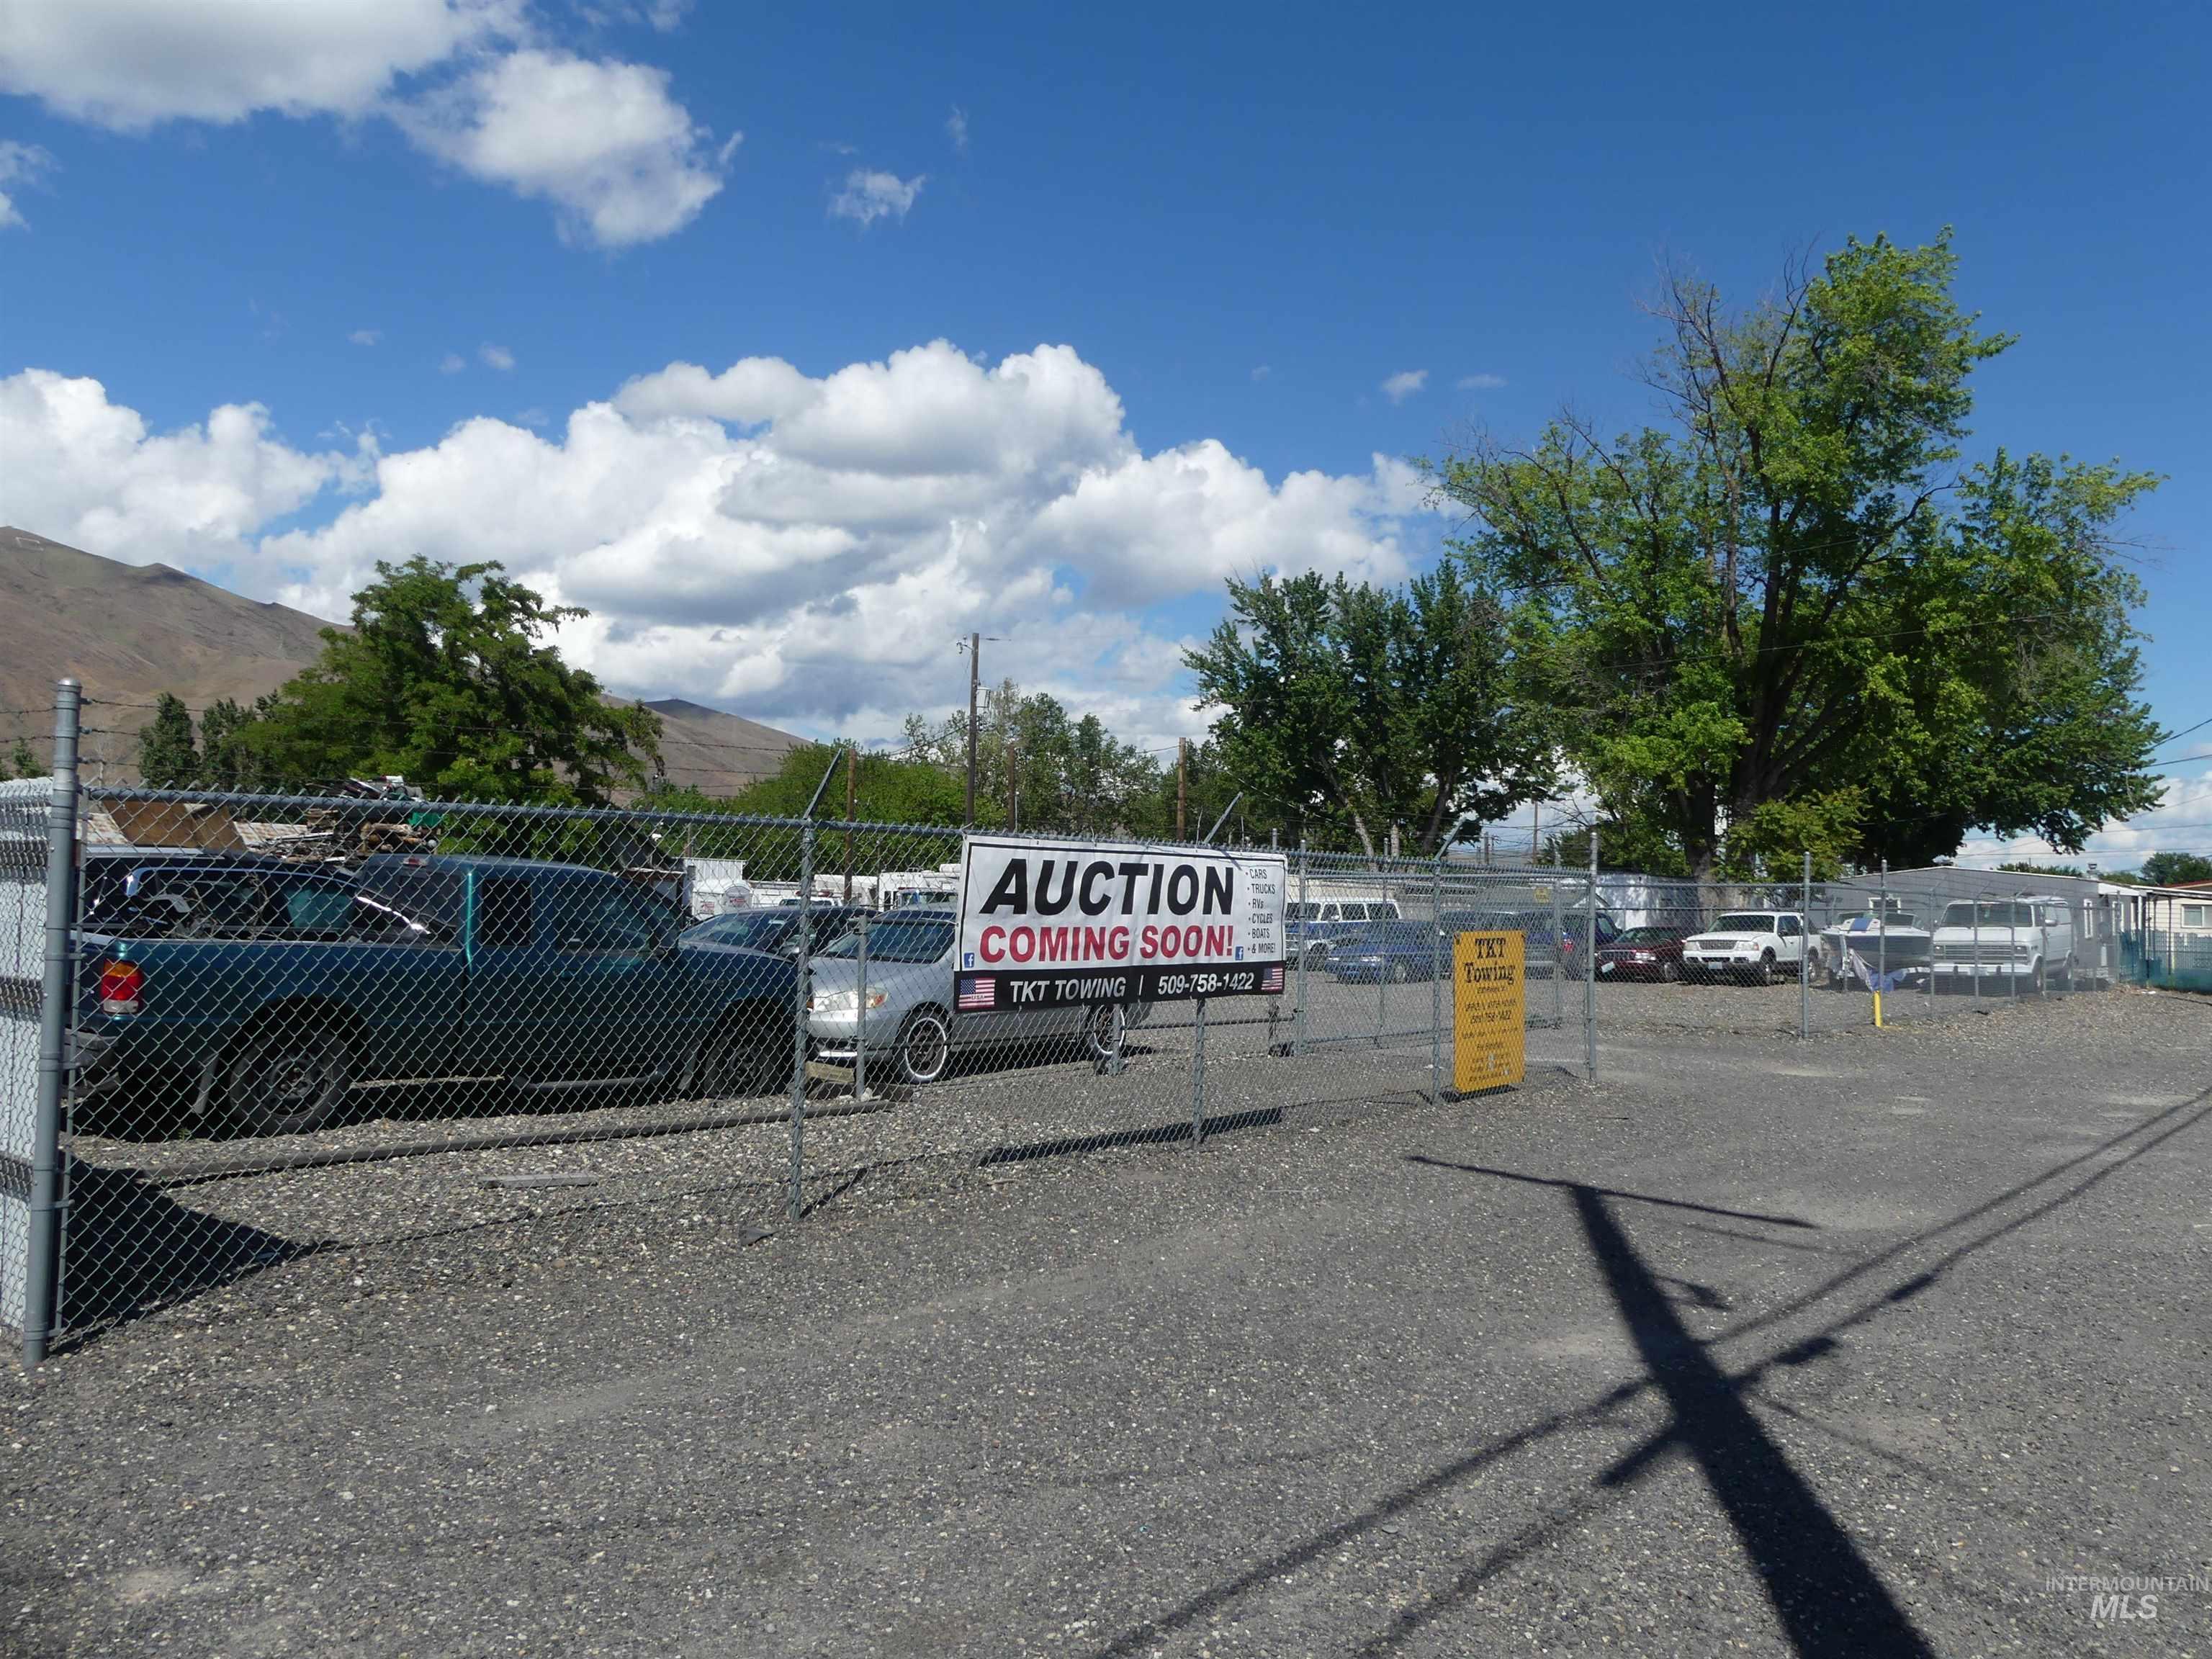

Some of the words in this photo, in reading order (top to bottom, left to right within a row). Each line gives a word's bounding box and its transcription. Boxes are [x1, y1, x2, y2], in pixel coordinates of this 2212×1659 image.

[1249, 868, 1267, 879] CARS
[979, 858, 1233, 916] AUCTION
[1251, 884, 1276, 894] TRUCKS
[1252, 898, 1264, 909] RVs
[1251, 913, 1273, 923] CYCLES
[1251, 927, 1270, 939] BOATS
[980, 925, 1130, 963] COMING
[1140, 925, 1233, 959] SOON!
[1251, 943, 1256, 953] &
[1258, 943, 1275, 953] MORE!
[1475, 938, 1506, 958] TKT
[1464, 961, 1516, 985] Towing
[1010, 981, 1050, 1002] TKT
[1055, 976, 1126, 1000] TOWING
[1158, 972, 1254, 995] 509-758-1422
